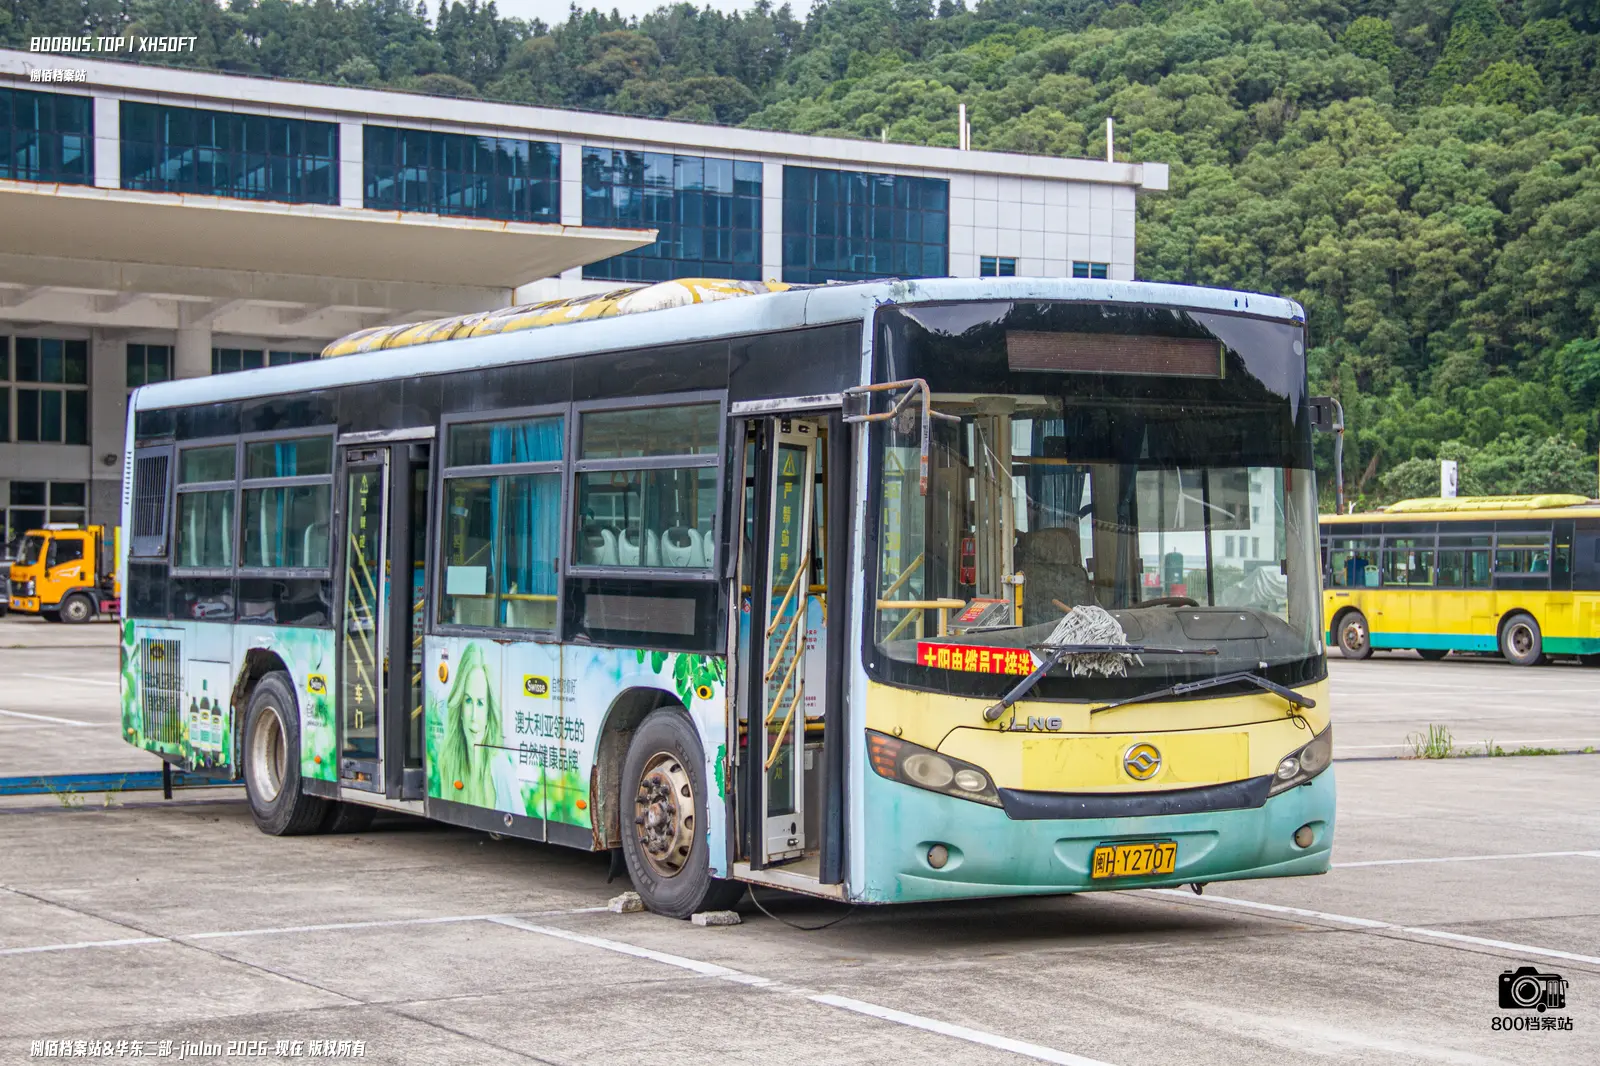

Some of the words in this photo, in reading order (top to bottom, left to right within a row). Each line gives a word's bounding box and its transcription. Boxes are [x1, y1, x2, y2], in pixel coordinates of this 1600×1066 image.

[353, 659, 365, 730] 下车门
[527, 679, 546, 693] Swisse
[515, 710, 585, 743] 澳大利亚领先的
[1010, 716, 1062, 731] LNG
[519, 741, 580, 773] 自然健康品牌
